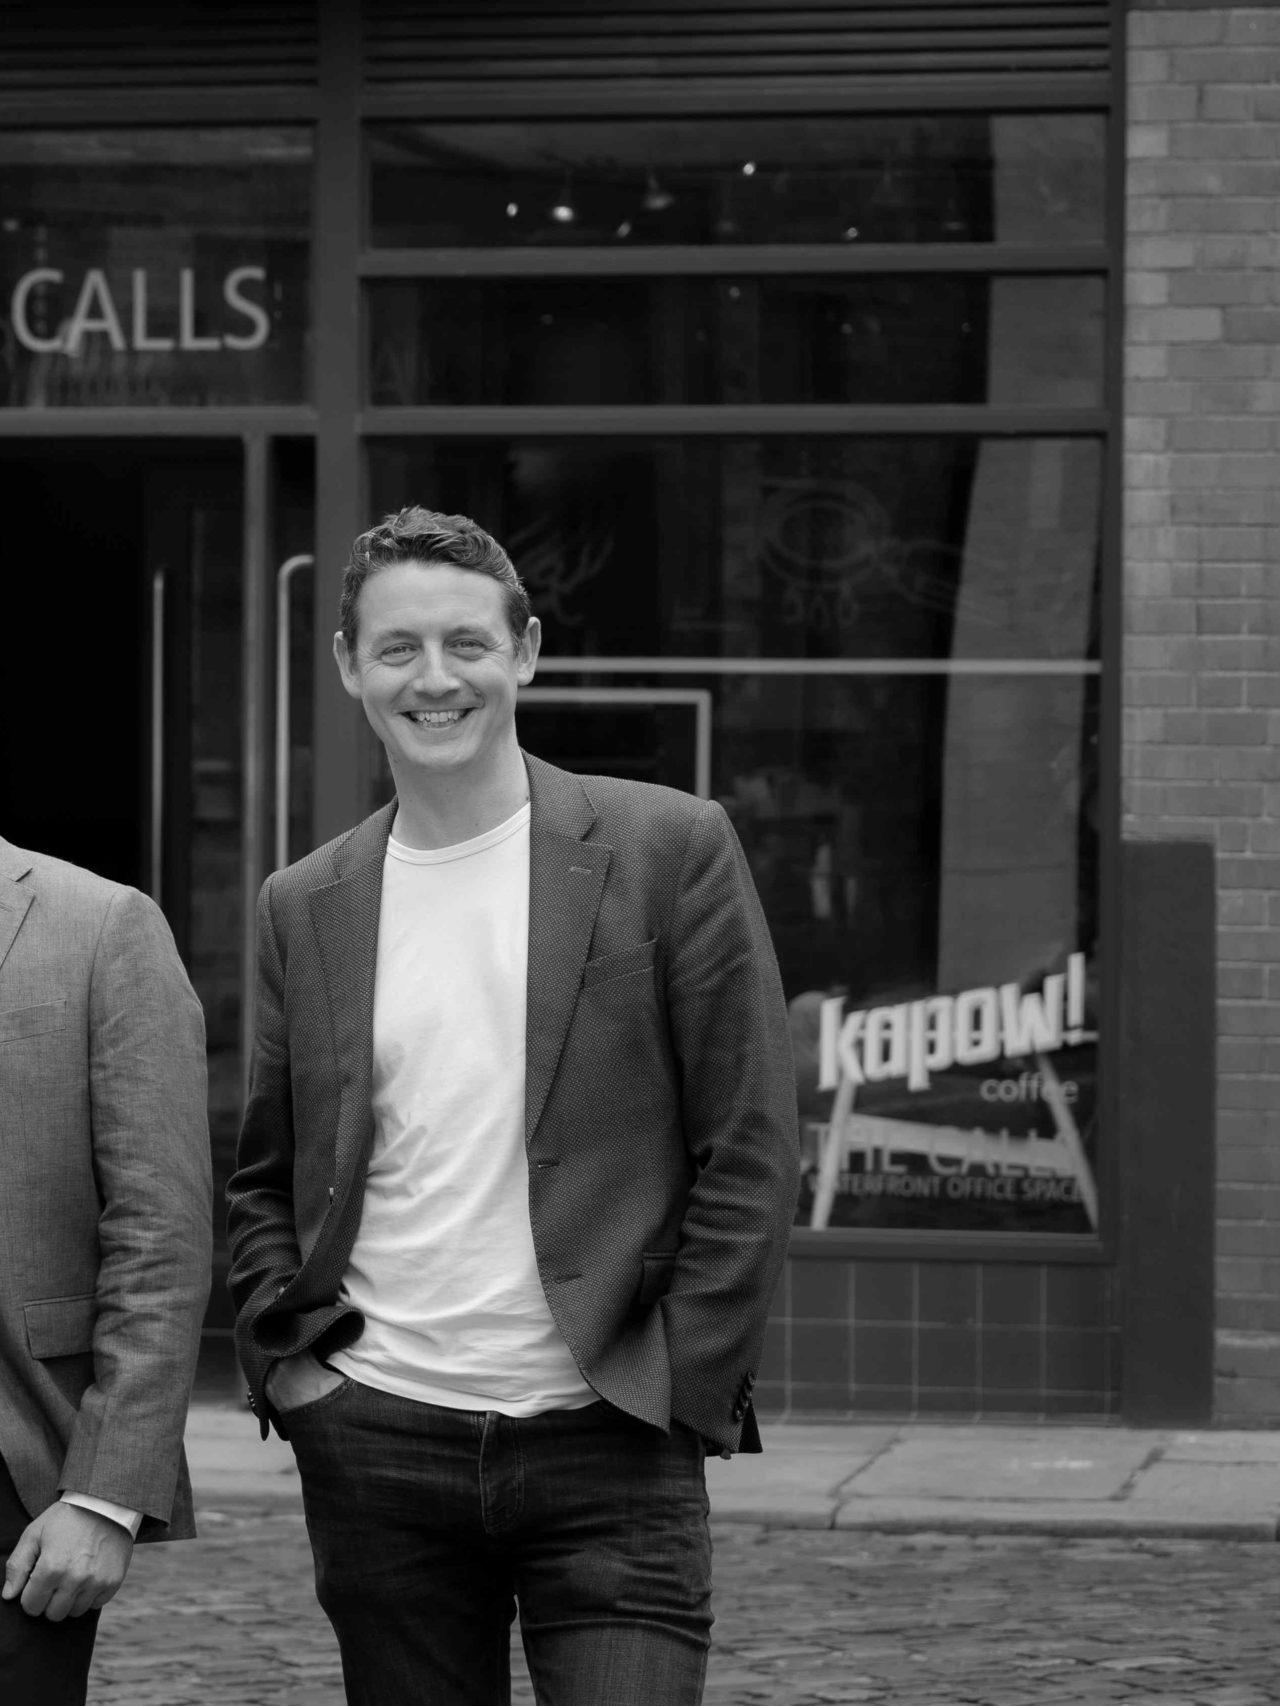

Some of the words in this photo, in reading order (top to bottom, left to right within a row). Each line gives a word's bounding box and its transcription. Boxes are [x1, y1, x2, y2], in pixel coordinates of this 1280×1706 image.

[11, 266, 271, 353] CALLS
[817, 952, 1086, 1092] kapow!
[808, 1175, 941, 1198] WTERFRONT
[947, 1175, 1016, 1200] OFFICE
